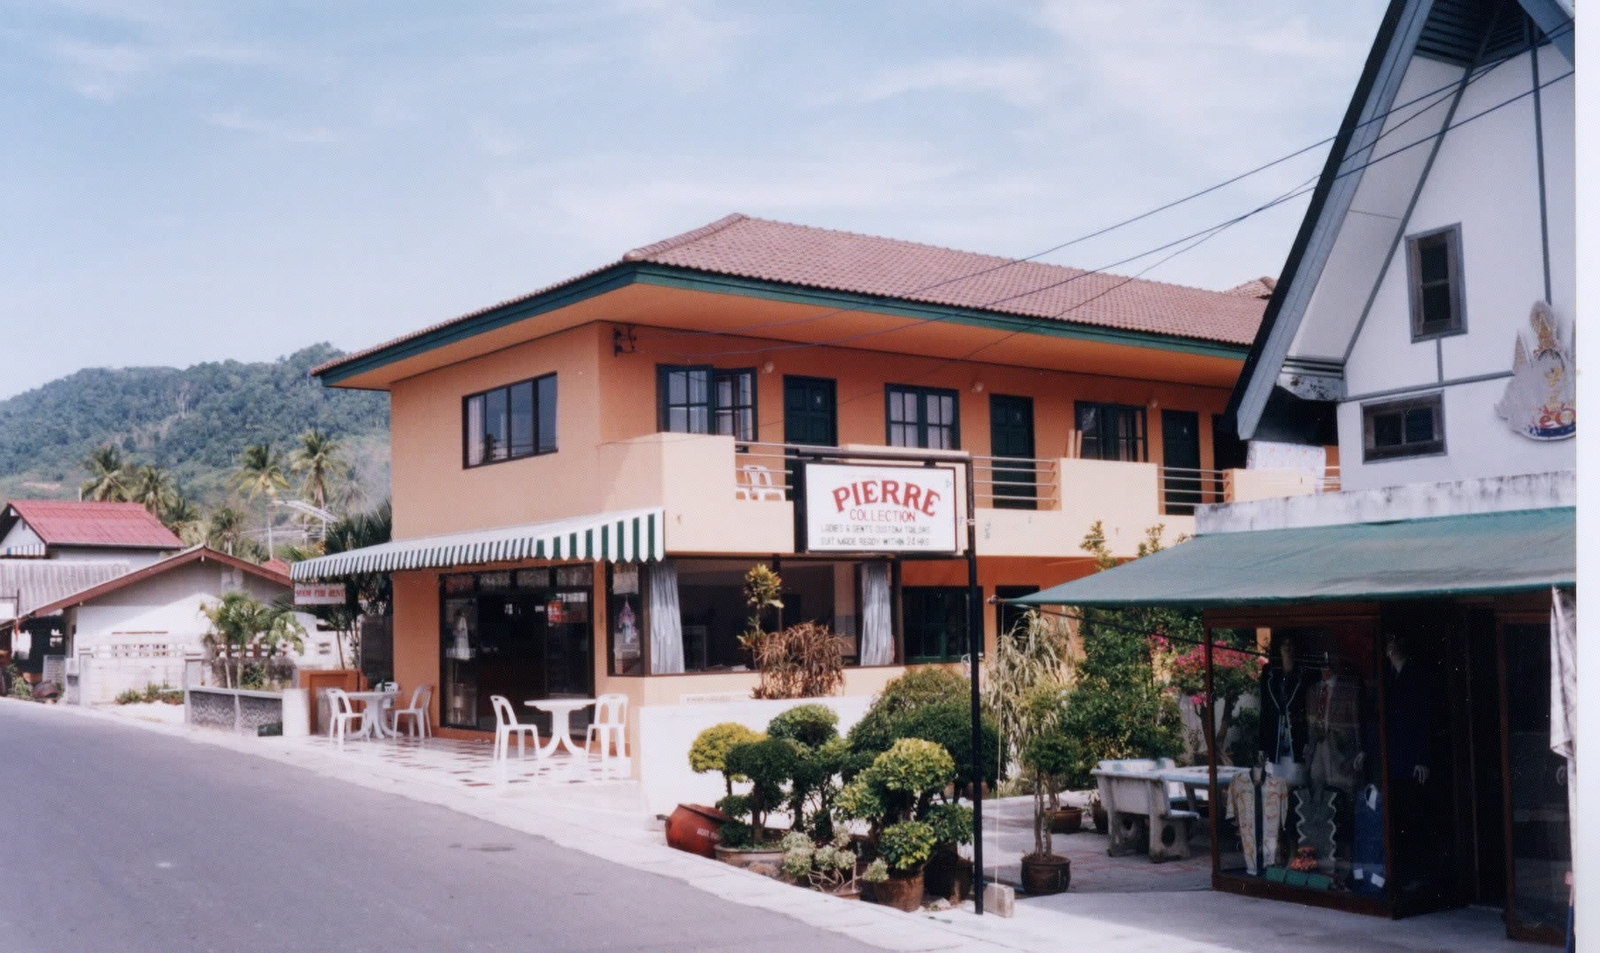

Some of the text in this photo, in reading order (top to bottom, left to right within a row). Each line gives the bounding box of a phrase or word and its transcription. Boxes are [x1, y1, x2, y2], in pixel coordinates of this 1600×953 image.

[831, 479, 941, 517] PIERRE
[849, 508, 916, 523] COLLECTION
[821, 523, 843, 533] LADIES
[875, 524, 902, 534] CUSTOM
[904, 525, 930, 534] TAILORS
[837, 537, 856, 546] MADE
[859, 537, 879, 546] READY
[883, 537, 904, 546] WITHIN
[917, 537, 929, 546] HRS
